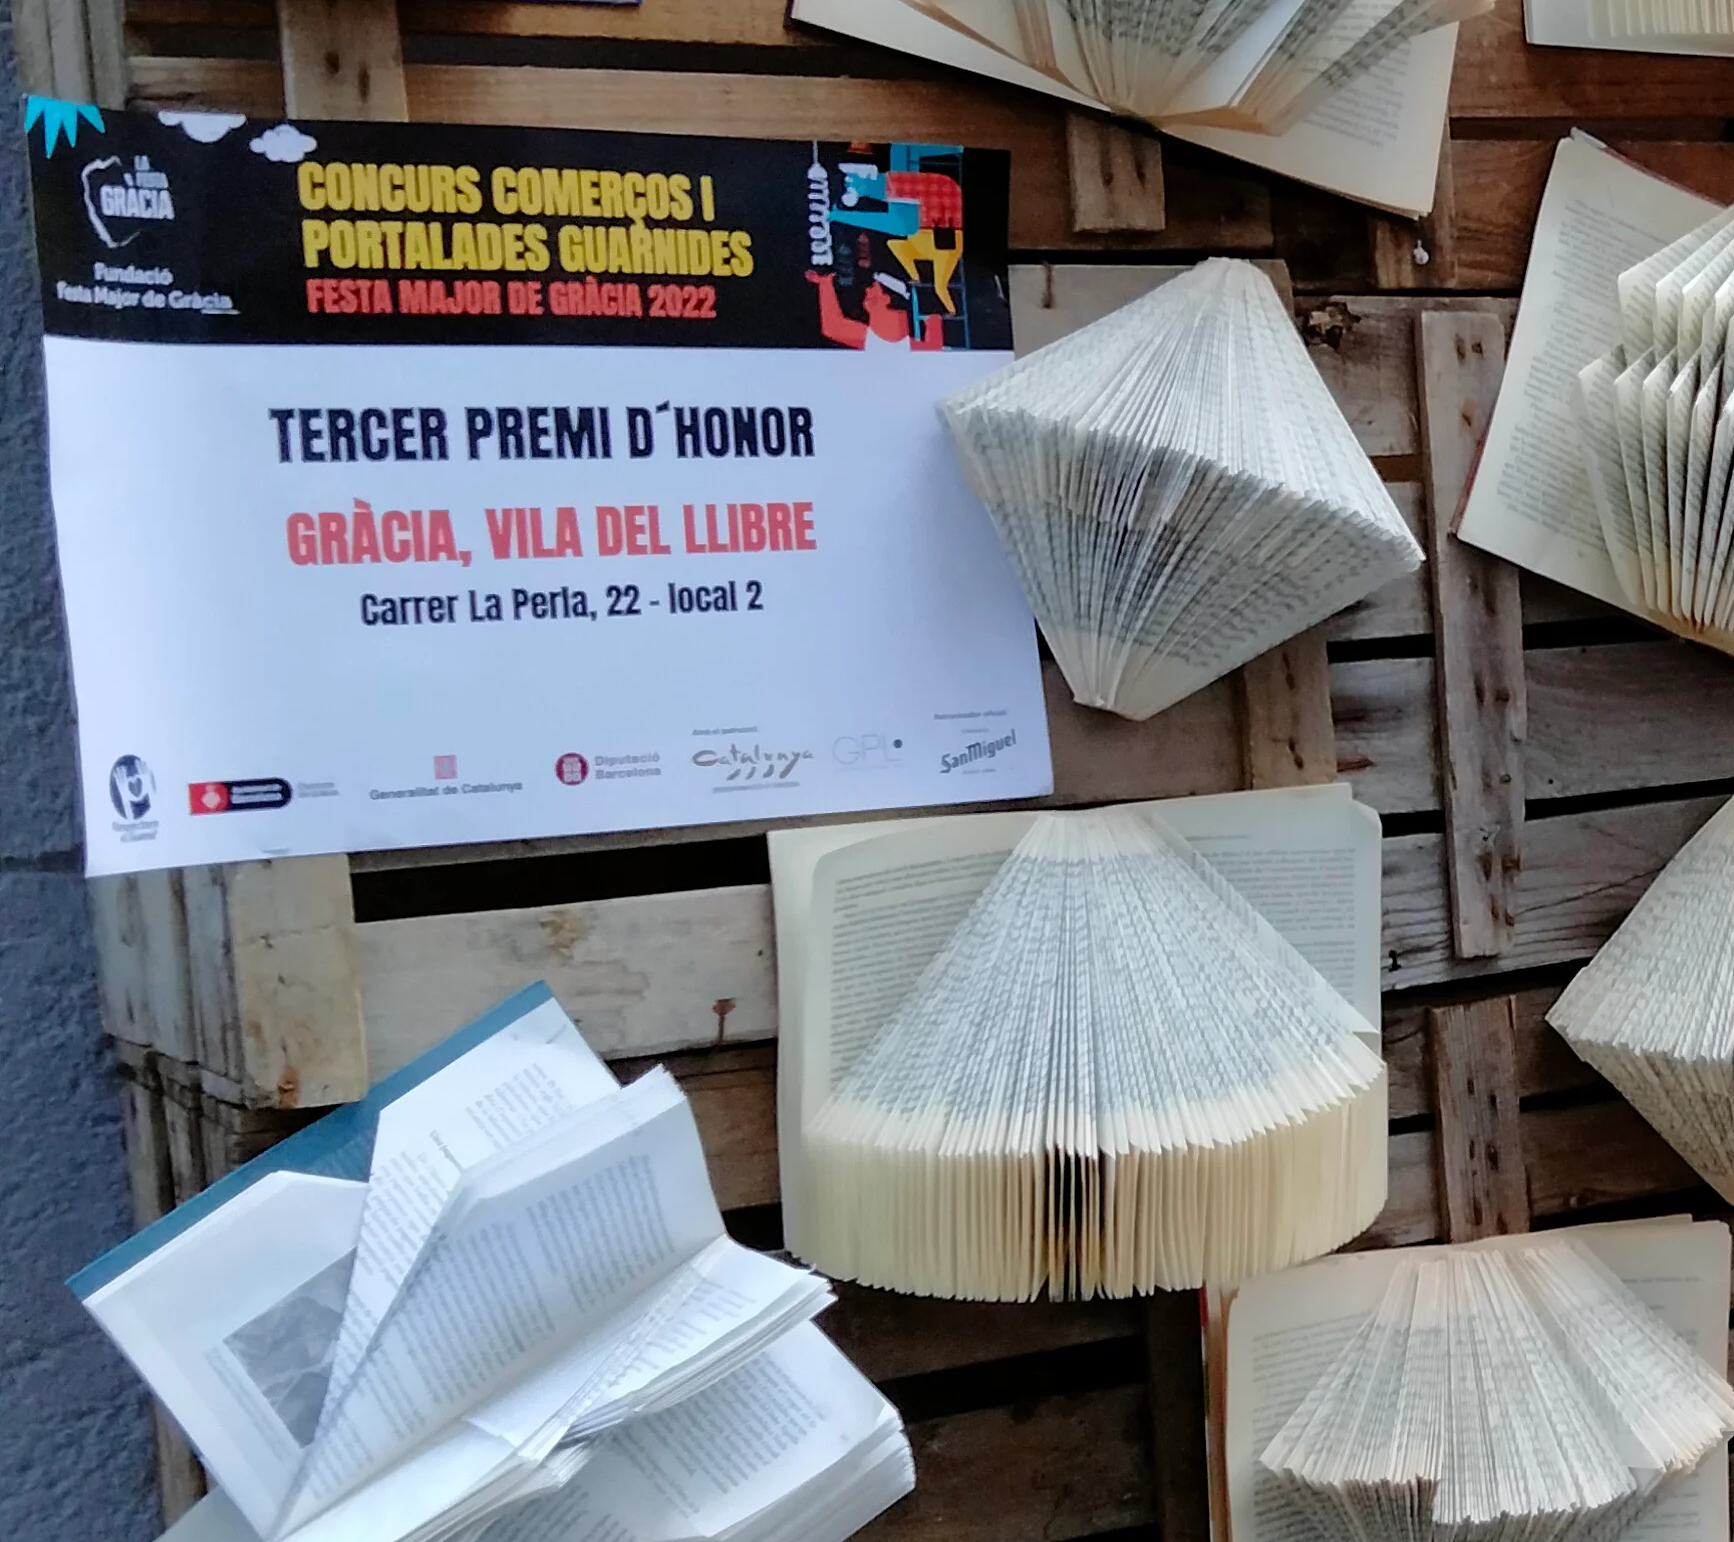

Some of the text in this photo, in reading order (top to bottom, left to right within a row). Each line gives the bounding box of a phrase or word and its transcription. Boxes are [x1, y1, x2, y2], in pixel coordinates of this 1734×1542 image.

[298, 161, 715, 224] CONCURS COMERÇOS I
[302, 219, 754, 277] PORTALADES GUARNIDES
[93, 262, 173, 285] Fundació
[94, 286, 140, 309] Major
[141, 290, 166, 308] de
[306, 275, 717, 318] FESTA MAJOR DE GRÀCIA 2022
[269, 408, 449, 463] TERCER
[464, 406, 613, 460] PREMI
[286, 497, 817, 568] GRÀCIA, VILA DEL LLIBRE
[360, 592, 458, 627] Carrer
[468, 590, 500, 621] La
[513, 586, 597, 623] Perla,
[606, 585, 641, 618] 22
[669, 580, 736, 615] local
[747, 580, 764, 612] 2
[594, 751, 660, 767] Diputació
[596, 766, 661, 781] Barcelona
[369, 780, 524, 801] Generalitat de Catalunya
